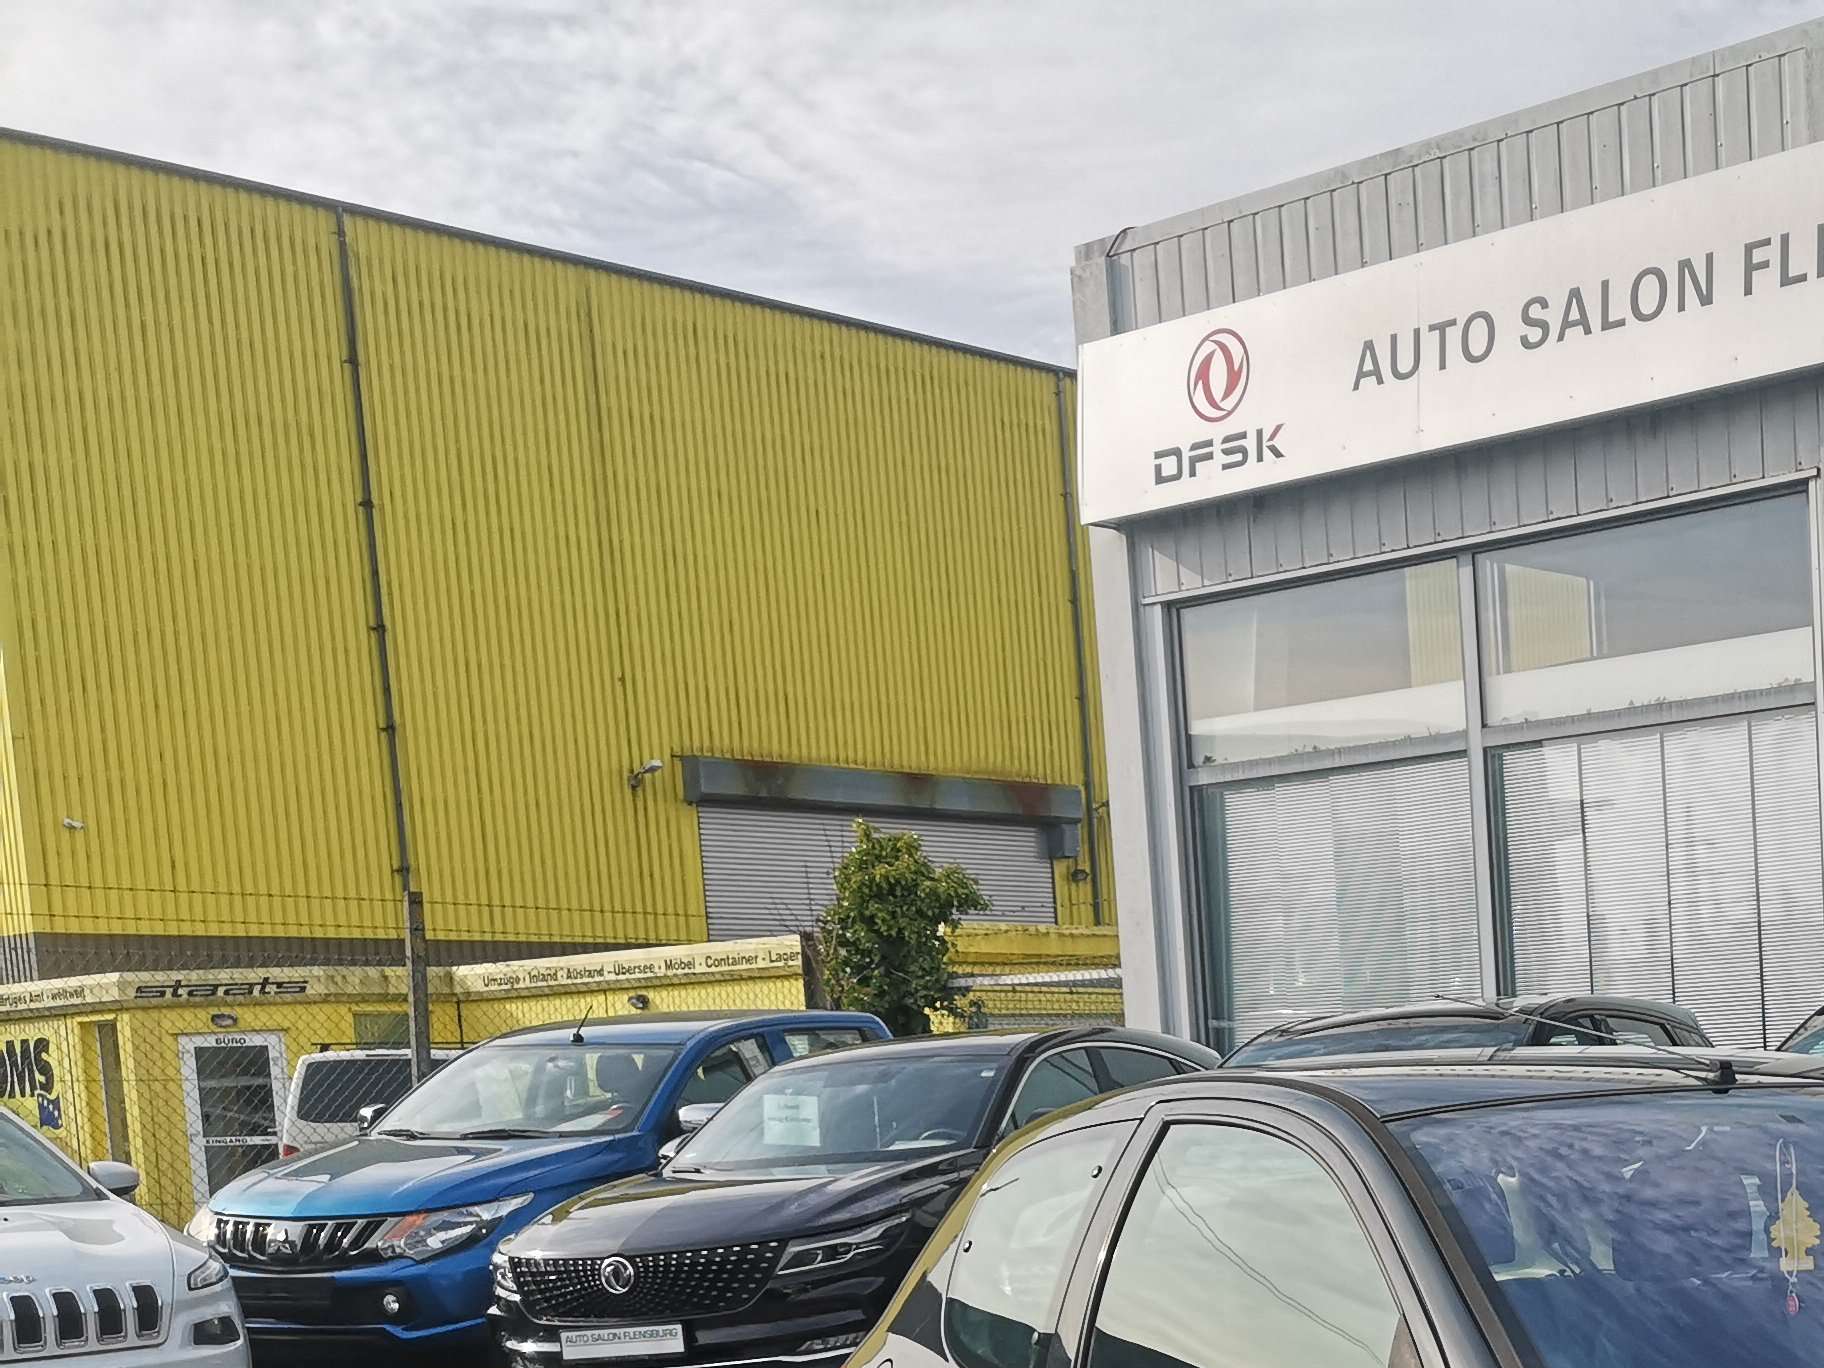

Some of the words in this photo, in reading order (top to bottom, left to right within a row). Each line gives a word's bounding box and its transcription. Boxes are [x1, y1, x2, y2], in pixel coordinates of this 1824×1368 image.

[1352, 310, 1496, 391] AUTO
[1519, 251, 1715, 350] SALON
[1154, 423, 1286, 485] DFSK
[528, 970, 558, 983] Inland
[705, 954, 759, 968] Container
[768, 950, 800, 965] Lager
[134, 976, 309, 999] staats
[565, 1333, 589, 1344] AUTO
[591, 1331, 621, 1342] SALON
[623, 1328, 678, 1340] FLENSBURG
